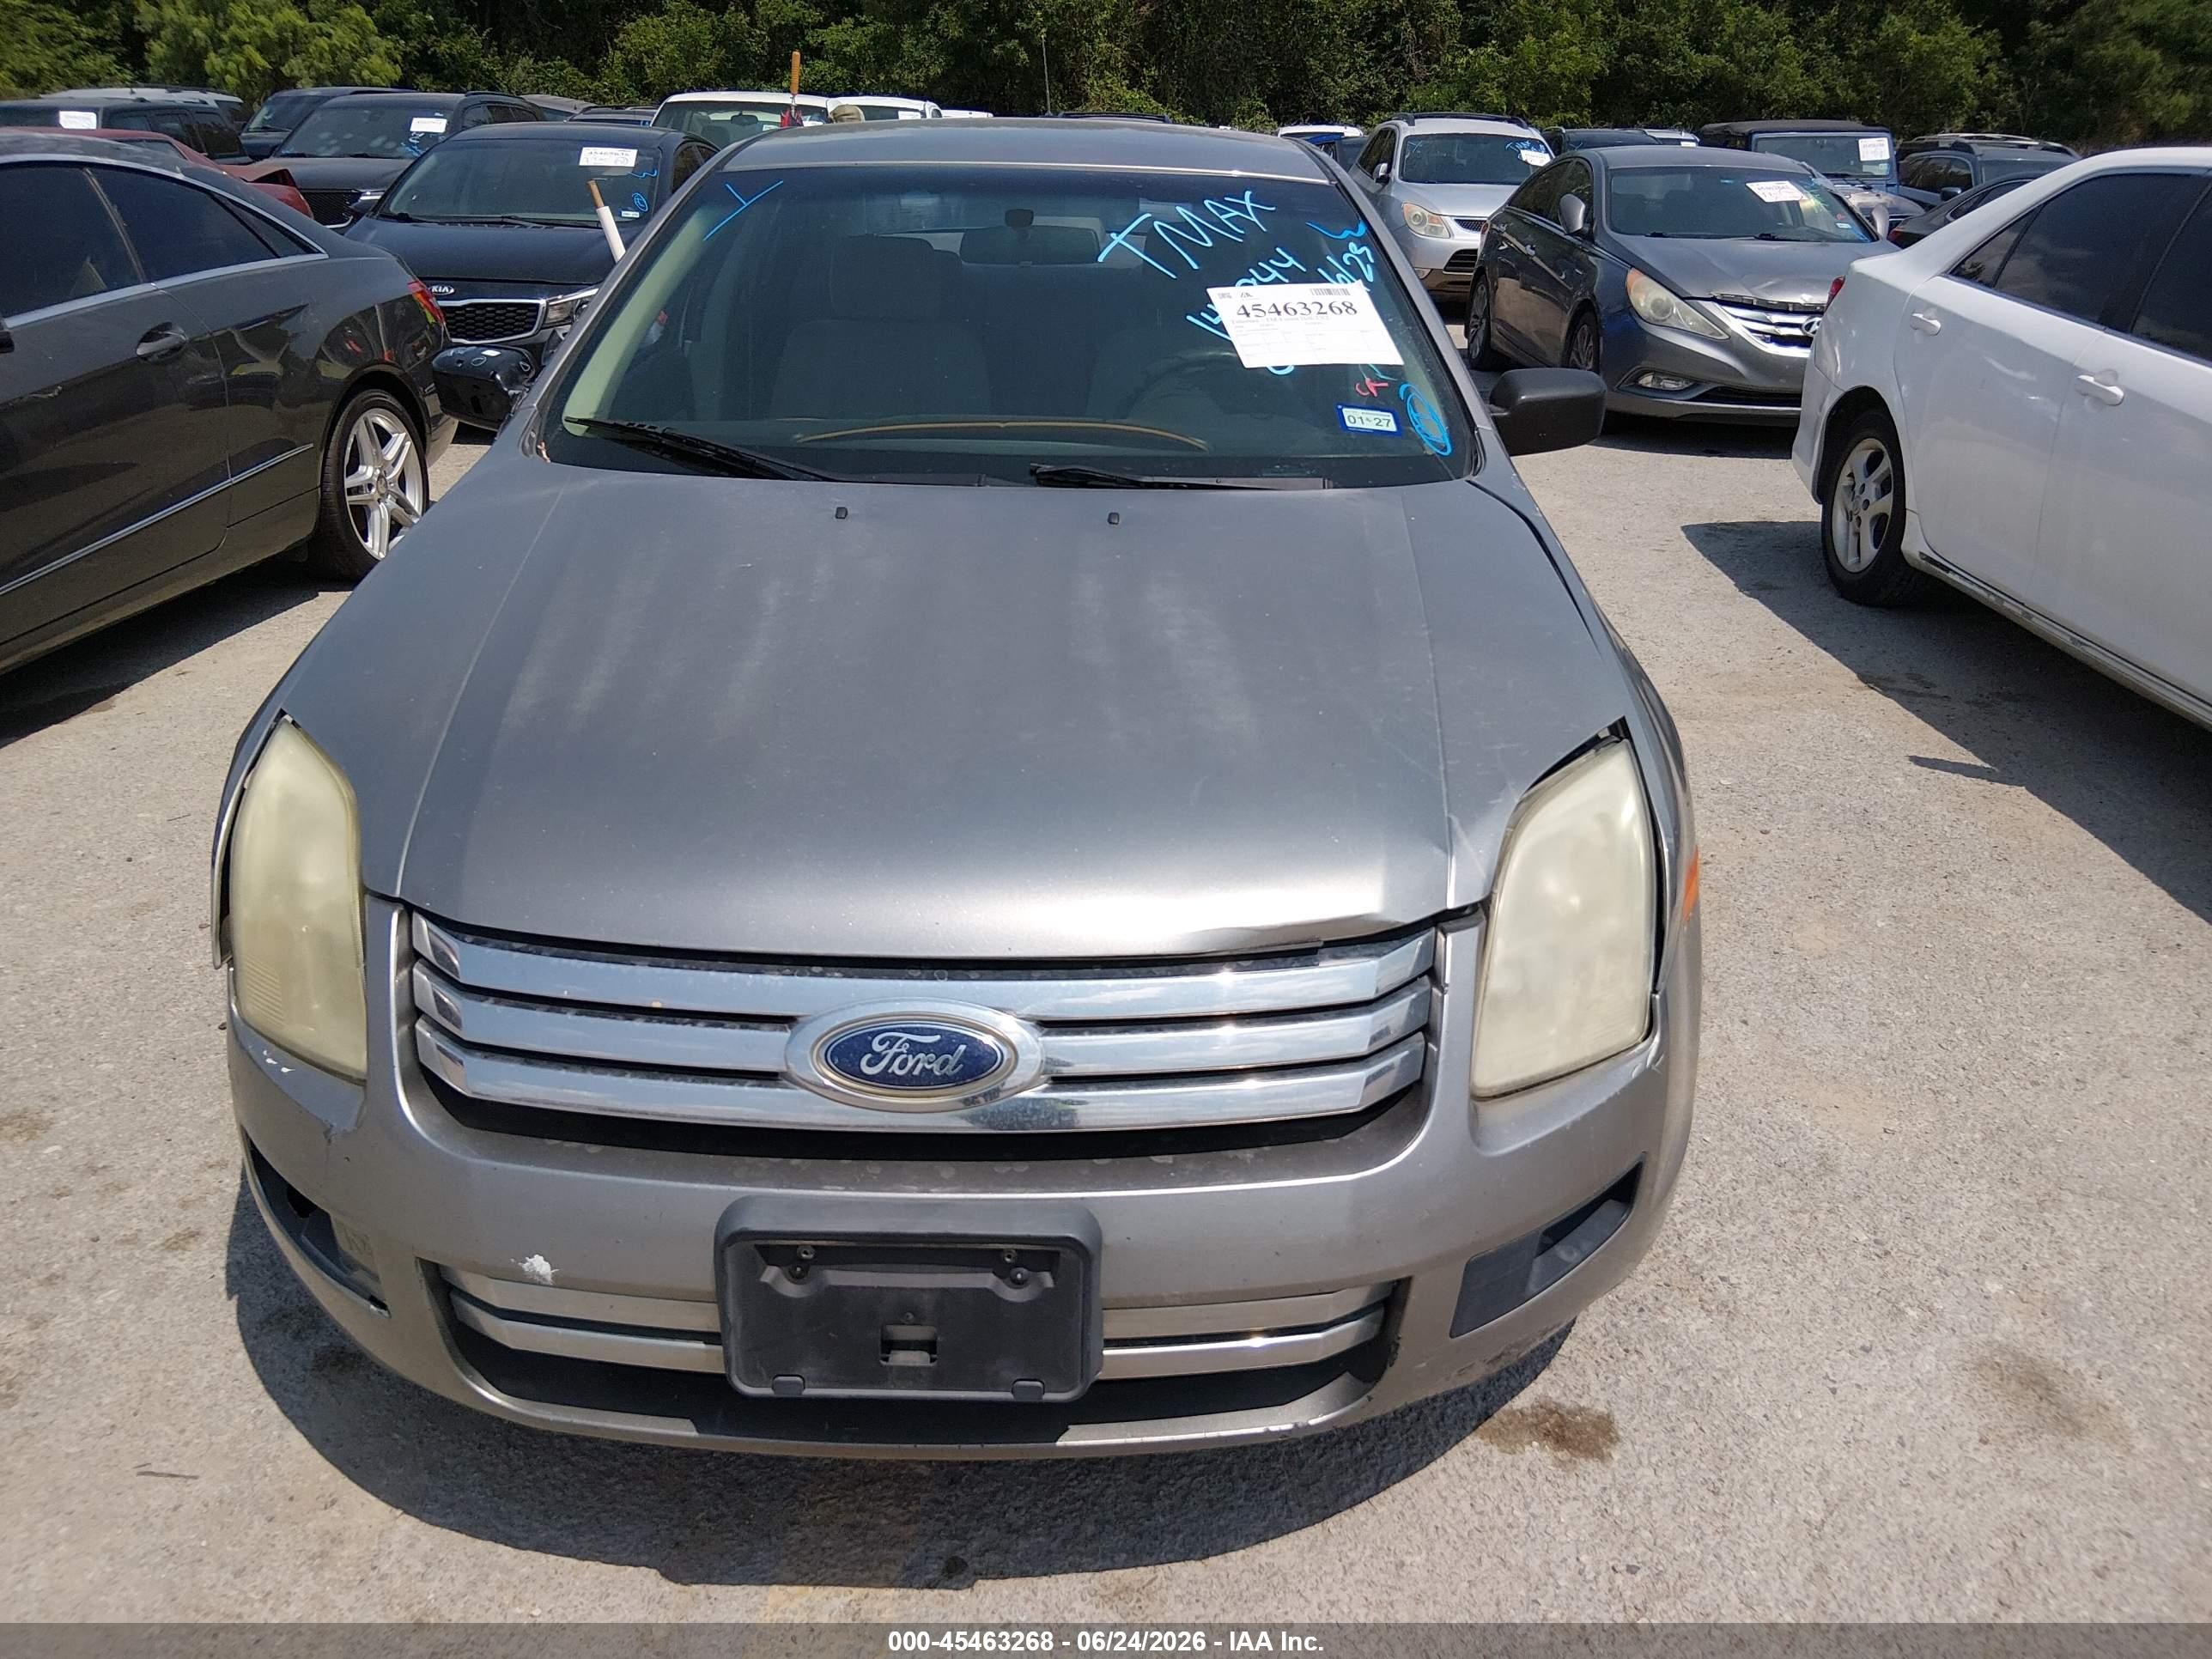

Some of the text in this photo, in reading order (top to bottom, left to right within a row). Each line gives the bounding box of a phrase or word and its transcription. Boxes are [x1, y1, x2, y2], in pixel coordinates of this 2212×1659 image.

[1097, 190, 1277, 280] TMAX
[1237, 301, 1358, 319] 45463268
[1347, 415, 1391, 428] 01 27
[860, 1031, 968, 1076] Ford
